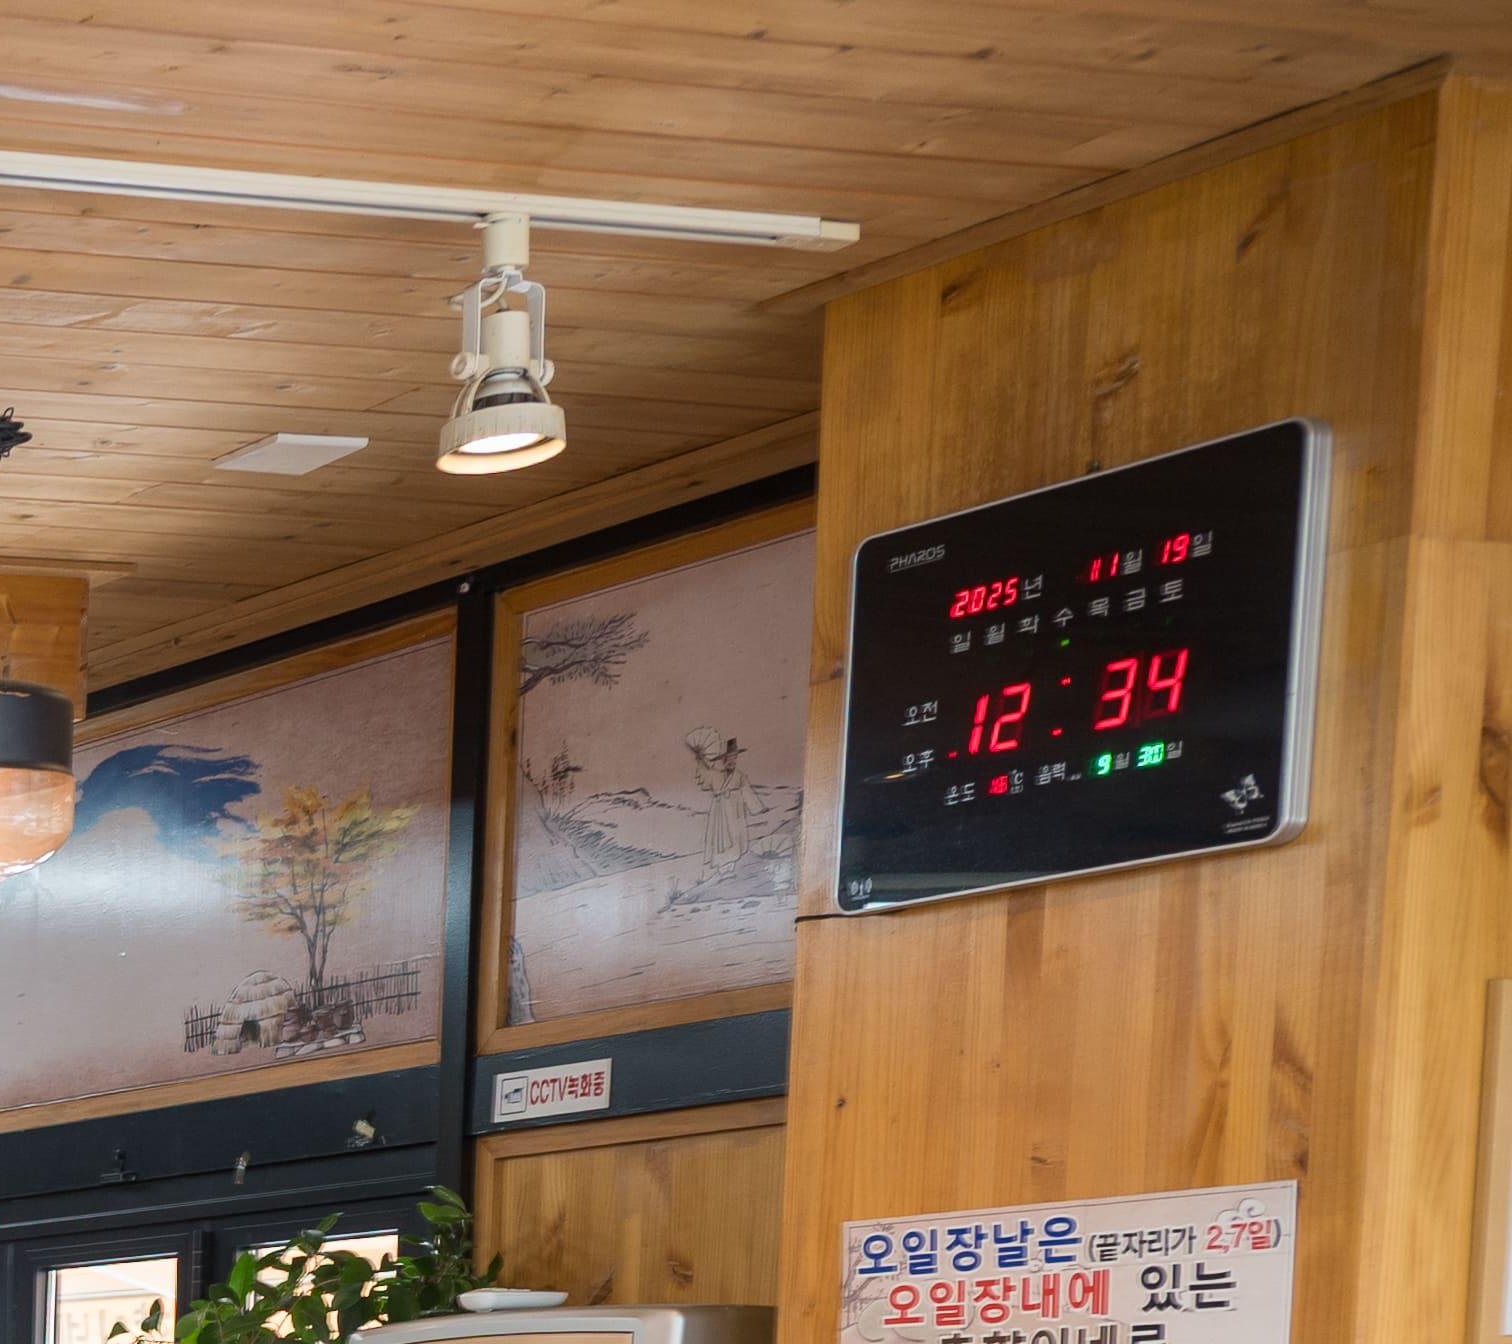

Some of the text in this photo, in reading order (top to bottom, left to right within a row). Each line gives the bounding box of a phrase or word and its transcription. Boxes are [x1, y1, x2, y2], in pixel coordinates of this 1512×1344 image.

[888, 544, 946, 571] PHAROS
[949, 574, 1044, 619] 2025년
[1161, 531, 1213, 563] 19일
[950, 579, 1183, 653] 일 월 화 수 목 금 토
[902, 701, 939, 727] 오전
[901, 749, 935, 774] 오후
[944, 783, 975, 806] 온도
[1034, 761, 1067, 786] 음력
[530, 1071, 605, 1105] CCTV녹화중
[855, 1216, 1282, 1277] 오일장날은 (끝자리가 2,7일)
[883, 1263, 1238, 1327] 오일장내에 있는
